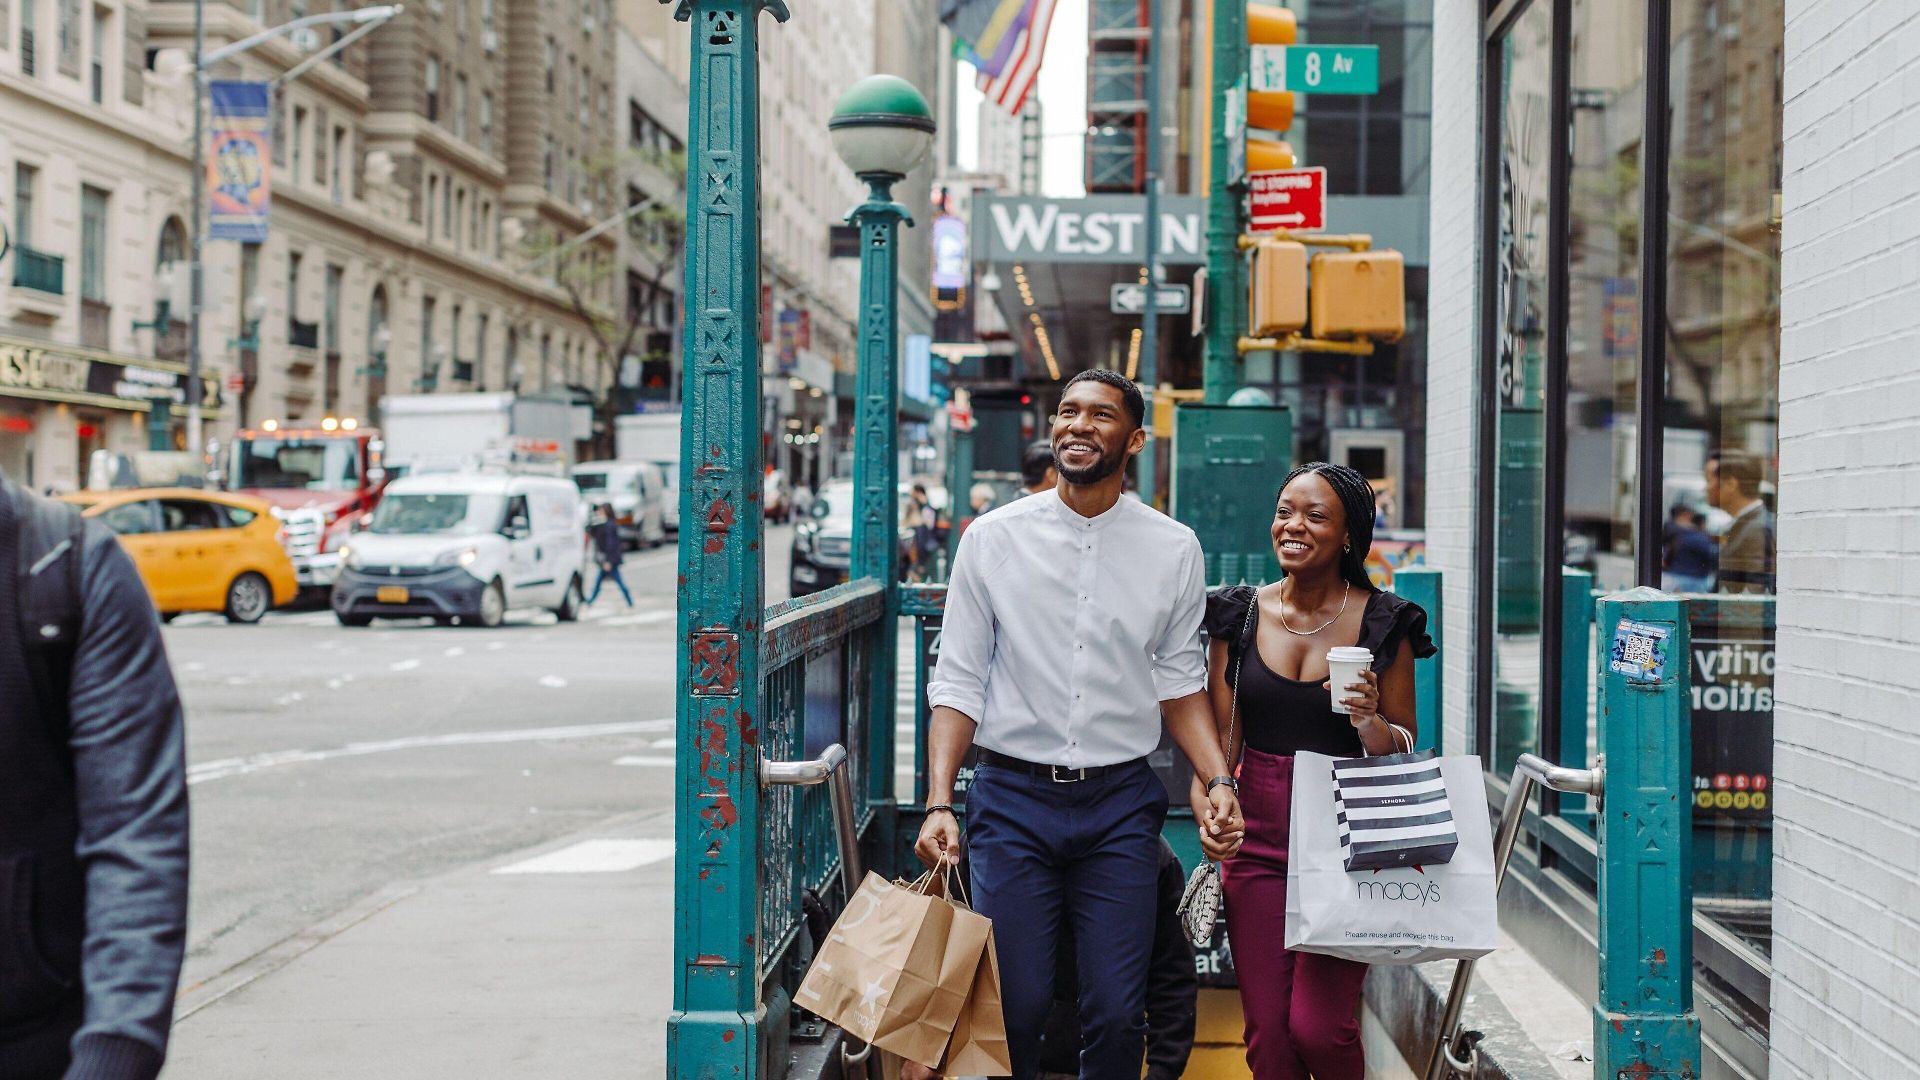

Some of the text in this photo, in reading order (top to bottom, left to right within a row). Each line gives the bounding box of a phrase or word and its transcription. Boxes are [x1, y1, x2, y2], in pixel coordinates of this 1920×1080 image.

[1305, 52, 1321, 86] 8
[1333, 53, 1354, 73] Av
[1266, 174, 1312, 191] STOPPING
[990, 204, 1199, 254] WESTN
[1357, 881, 1440, 907] macy's
[1345, 930, 1368, 938] Please
[1402, 931, 1427, 940] recycle
[1427, 933, 1439, 941] this
[1440, 933, 1456, 943] bag.
